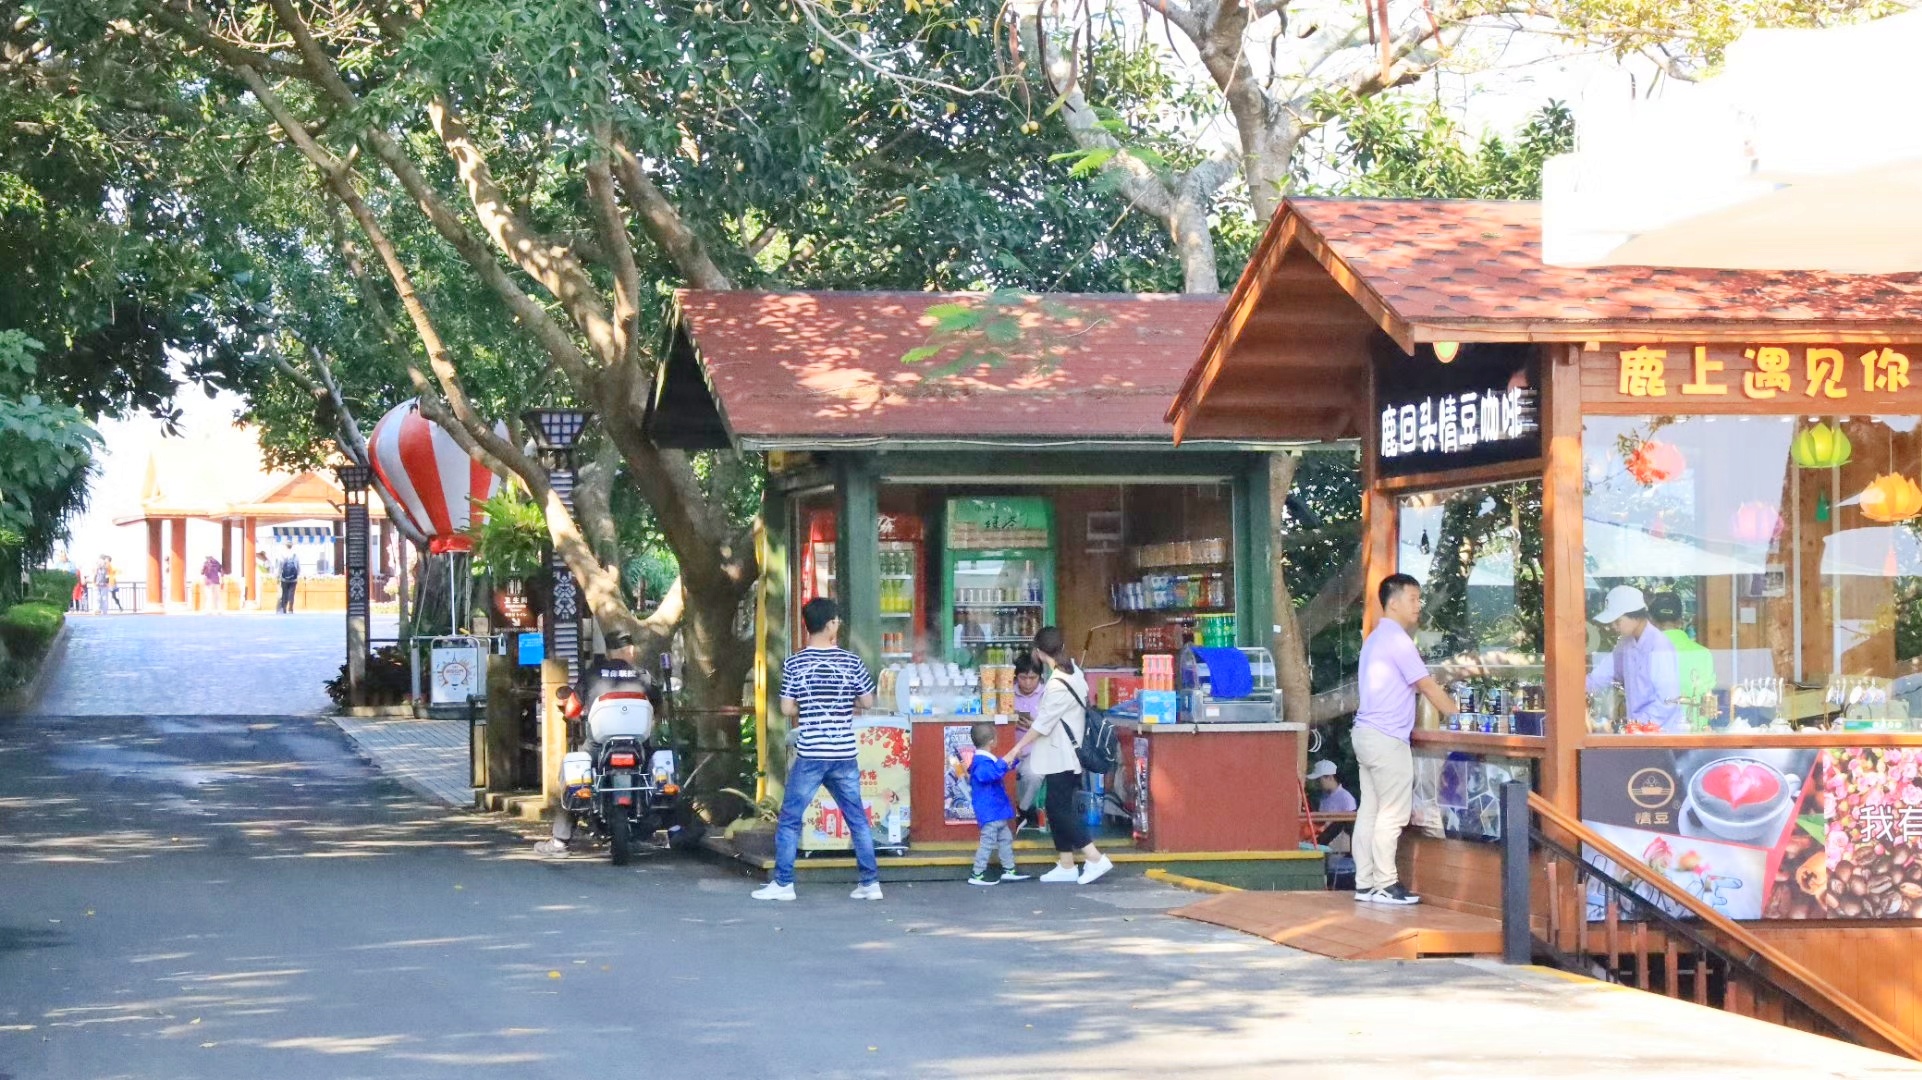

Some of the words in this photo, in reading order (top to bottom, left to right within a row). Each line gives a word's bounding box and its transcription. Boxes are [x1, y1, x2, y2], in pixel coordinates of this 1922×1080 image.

[1619, 345, 1910, 399] 鹿上遇见你
[1381, 387, 1523, 457] 鹿回头情豆咖啡
[1860, 805, 1922, 842] 我有
